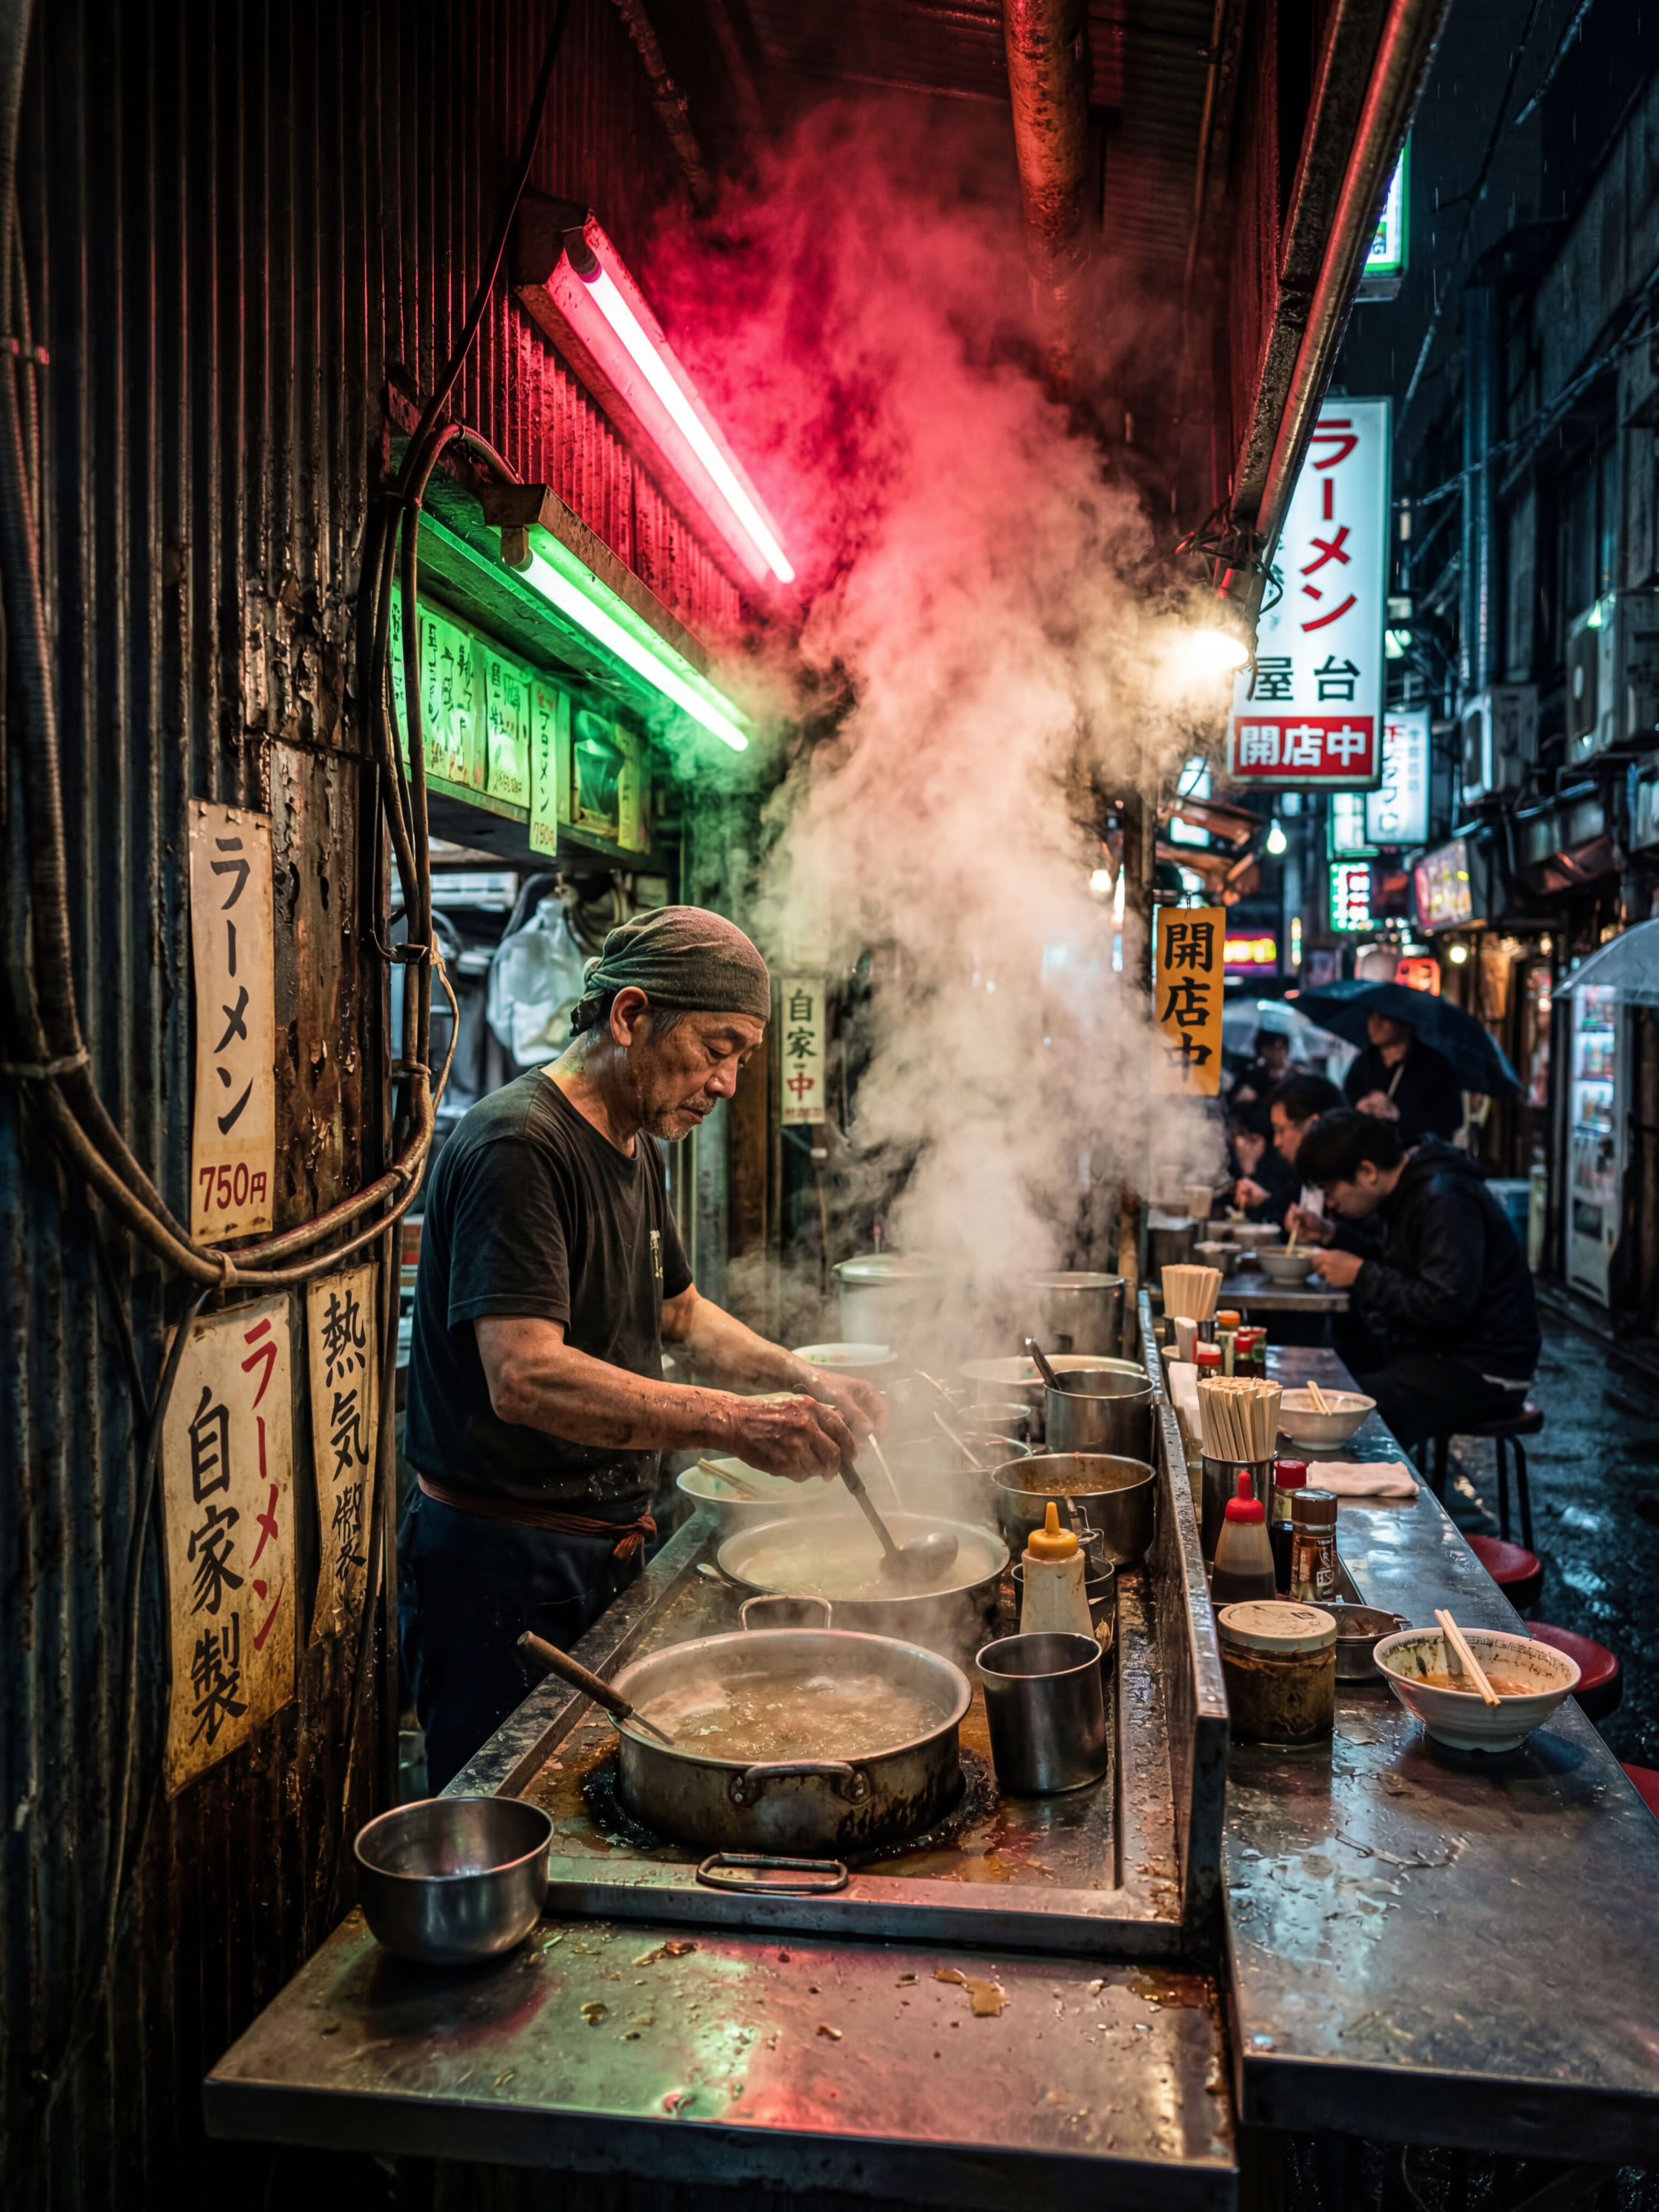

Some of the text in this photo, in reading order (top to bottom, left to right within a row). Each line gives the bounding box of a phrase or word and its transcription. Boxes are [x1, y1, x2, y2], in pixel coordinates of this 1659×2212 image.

[1300, 419, 1358, 632] ラーメン
[1239, 725, 1366, 766] 開店中
[1253, 655, 1361, 702] 屋台
[210, 836, 253, 1136] ラーメン
[1161, 922, 1215, 1083] 開店中
[198, 1162, 267, 1212] 750円
[187, 1386, 249, 1746] 自家製
[241, 1318, 286, 1652] ラーメン
